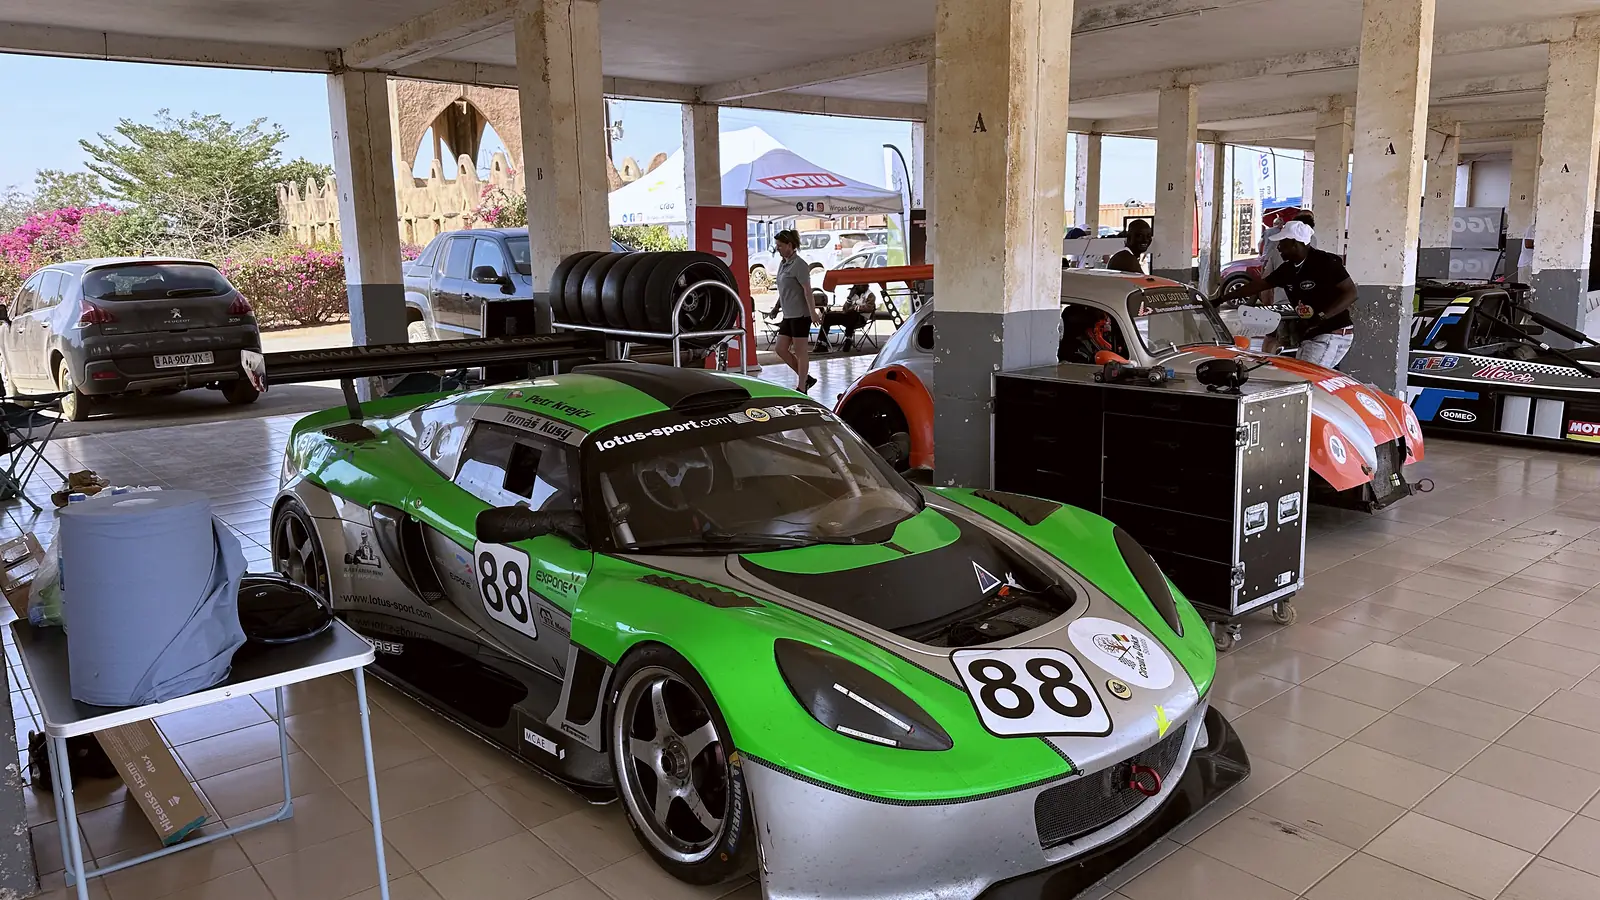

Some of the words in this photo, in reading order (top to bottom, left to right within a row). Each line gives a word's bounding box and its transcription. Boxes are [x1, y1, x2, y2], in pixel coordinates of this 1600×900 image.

[973, 112, 987, 133] A
[1384, 142, 1396, 156] A
[537, 167, 543, 180] B
[1560, 163, 1570, 174] A
[767, 174, 839, 188] MOTUL
[1167, 182, 1173, 191] B
[1325, 189, 1330, 197] B
[1146, 293, 1167, 304] DAVID
[1411, 355, 1459, 371] RFB
[525, 394, 550, 407] Petr
[550, 397, 595, 419] Krejčí
[1443, 411, 1473, 421] DOMEC
[502, 410, 540, 431] Tomáš
[541, 418, 574, 440] Kusý
[596, 414, 740, 452] lotus-sport.com
[479, 551, 528, 623] 88
[342, 594, 432, 620] www.lotus-sport.com
[968, 658, 1092, 719] 88
[525, 731, 546, 748] MCAE
[144, 790, 174, 832] Hisense
[728, 780, 742, 848] MICHELIN
